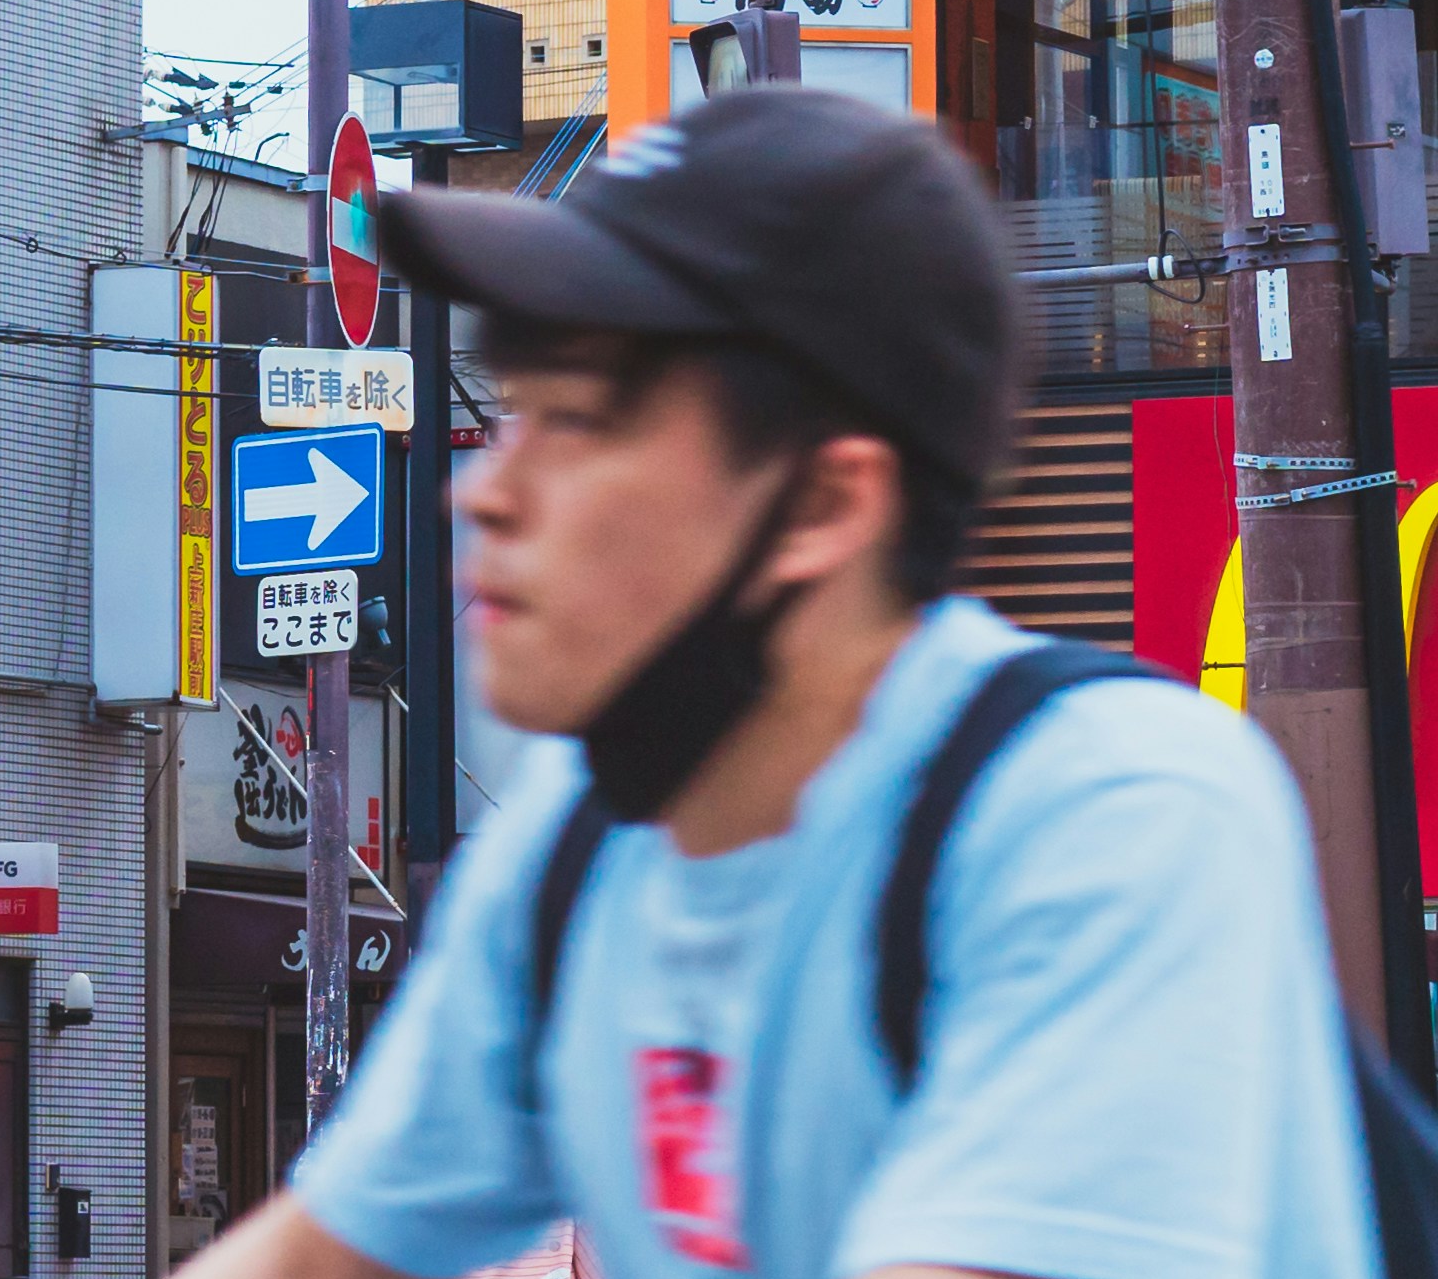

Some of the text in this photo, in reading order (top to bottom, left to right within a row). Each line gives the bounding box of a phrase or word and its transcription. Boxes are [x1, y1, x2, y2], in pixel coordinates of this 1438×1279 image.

[266, 367, 407, 414] 自転車を除く
[263, 579, 351, 612] 自転車を除く
[262, 611, 352, 651] ここまで
[281, 928, 392, 973] うん
